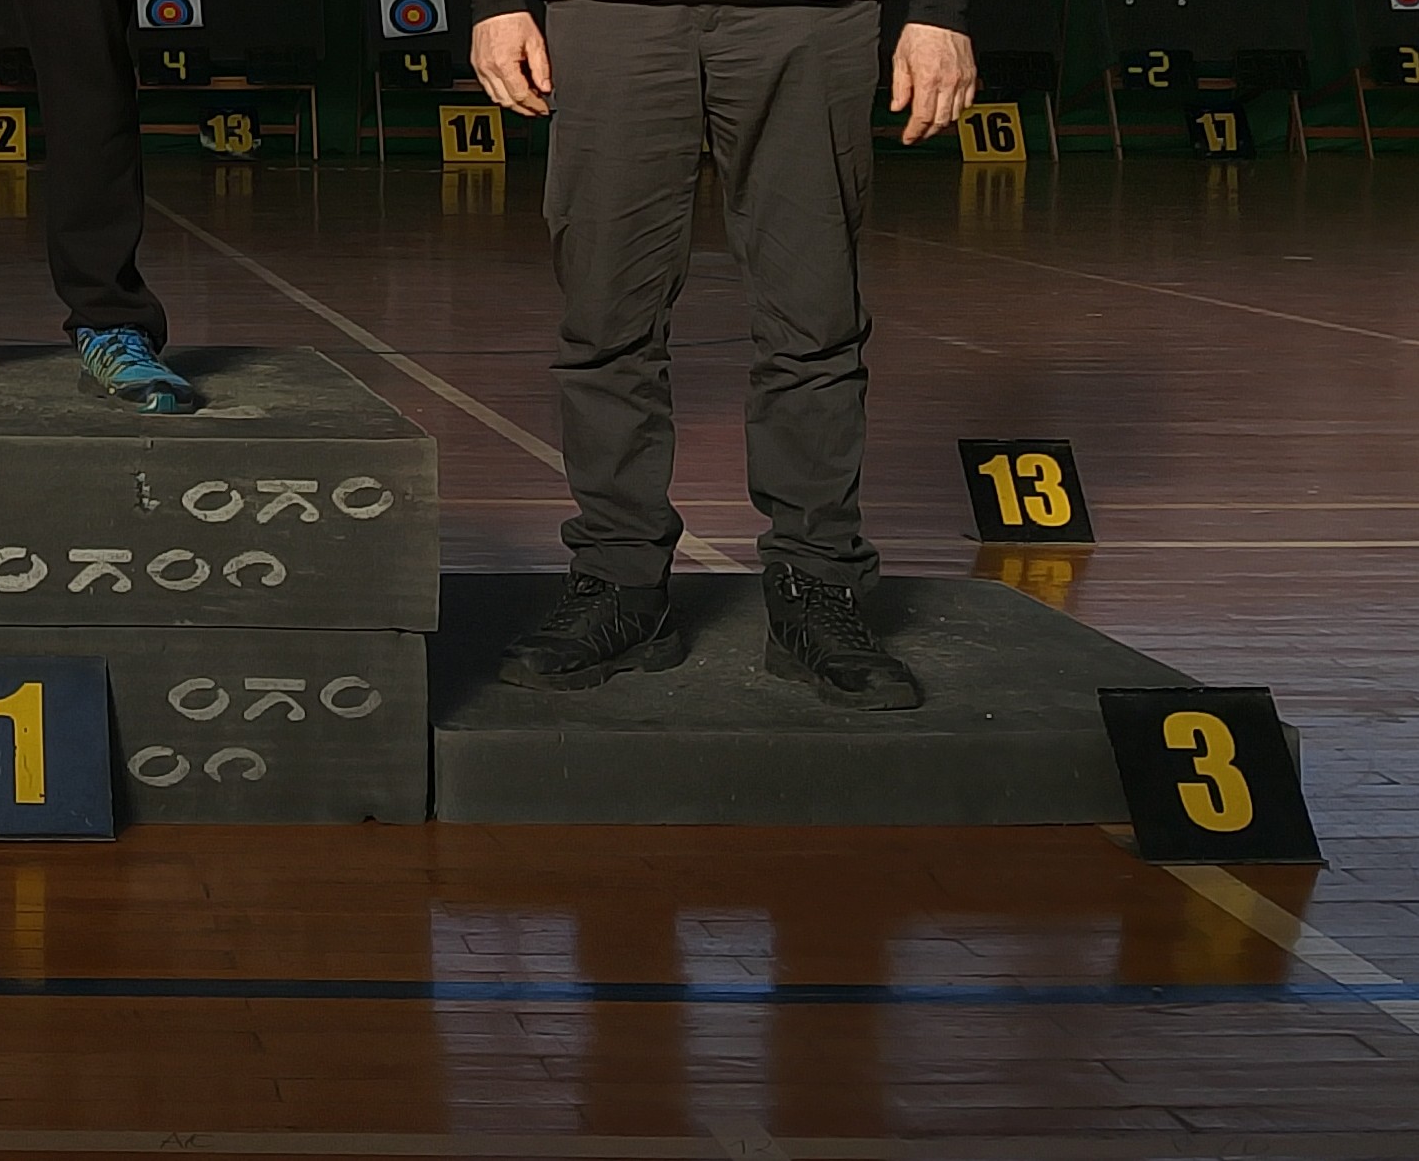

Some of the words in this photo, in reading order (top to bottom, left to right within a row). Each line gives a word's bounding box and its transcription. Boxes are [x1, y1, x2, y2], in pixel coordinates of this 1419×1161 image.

[163, 51, 186, 80] 4
[404, 54, 428, 83] 4
[207, 113, 253, 153] 13
[447, 113, 495, 153] 14
[964, 112, 1015, 153] 16
[1196, 112, 1237, 152] 17
[978, 453, 1072, 528] 13
[1163, 711, 1254, 833] 3
